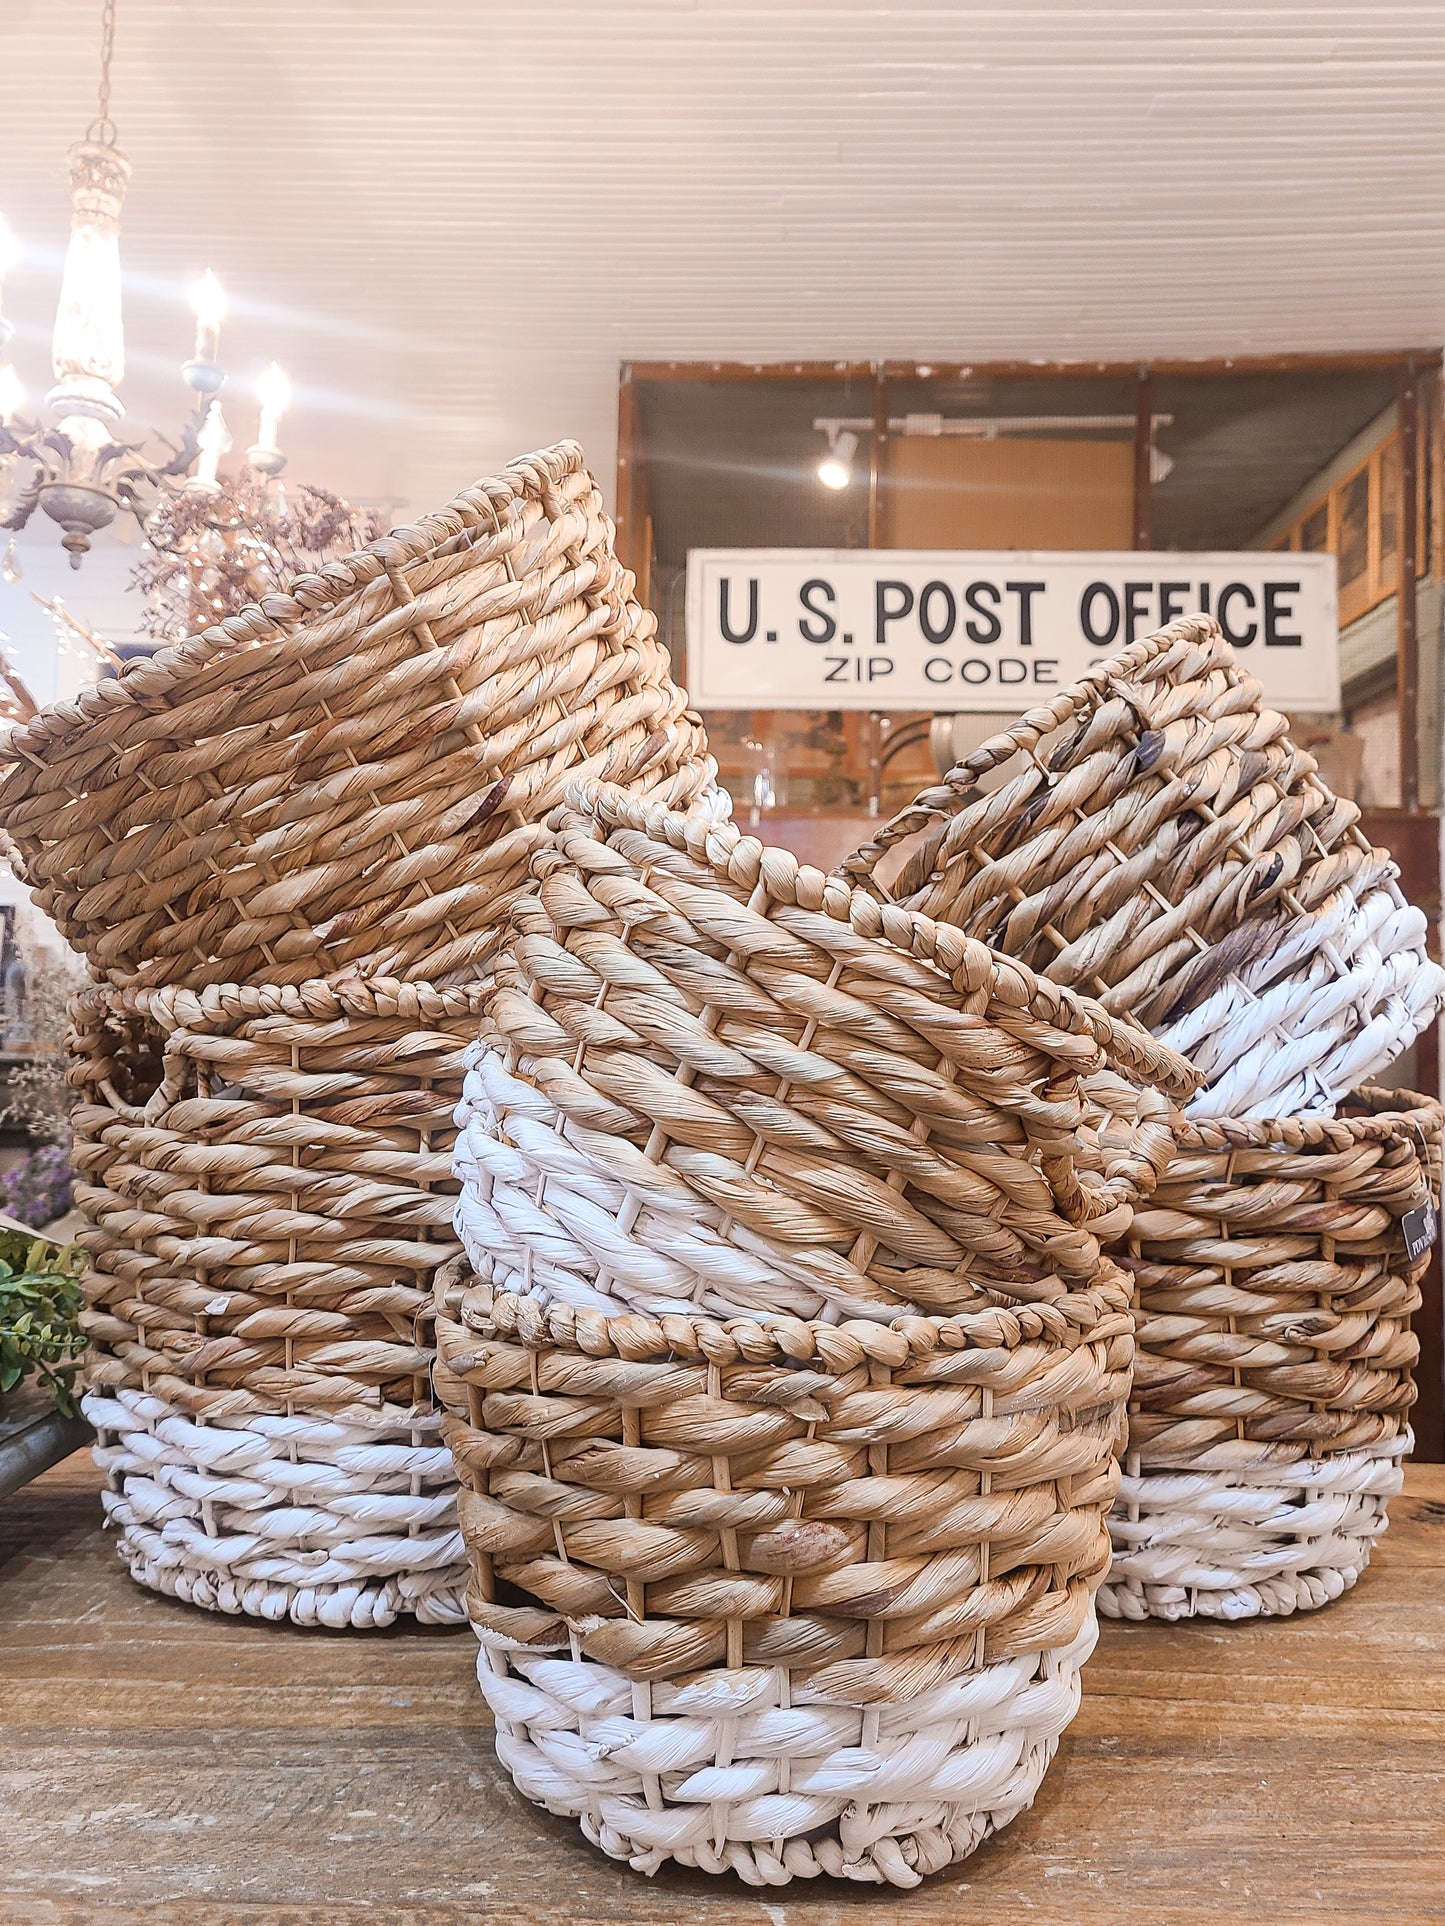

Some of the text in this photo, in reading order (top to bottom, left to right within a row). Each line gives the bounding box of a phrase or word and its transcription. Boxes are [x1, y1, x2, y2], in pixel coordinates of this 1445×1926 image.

[876, 580, 1046, 646] POST
[824, 657, 894, 683] ZIP
[924, 657, 1059, 684] CODE
